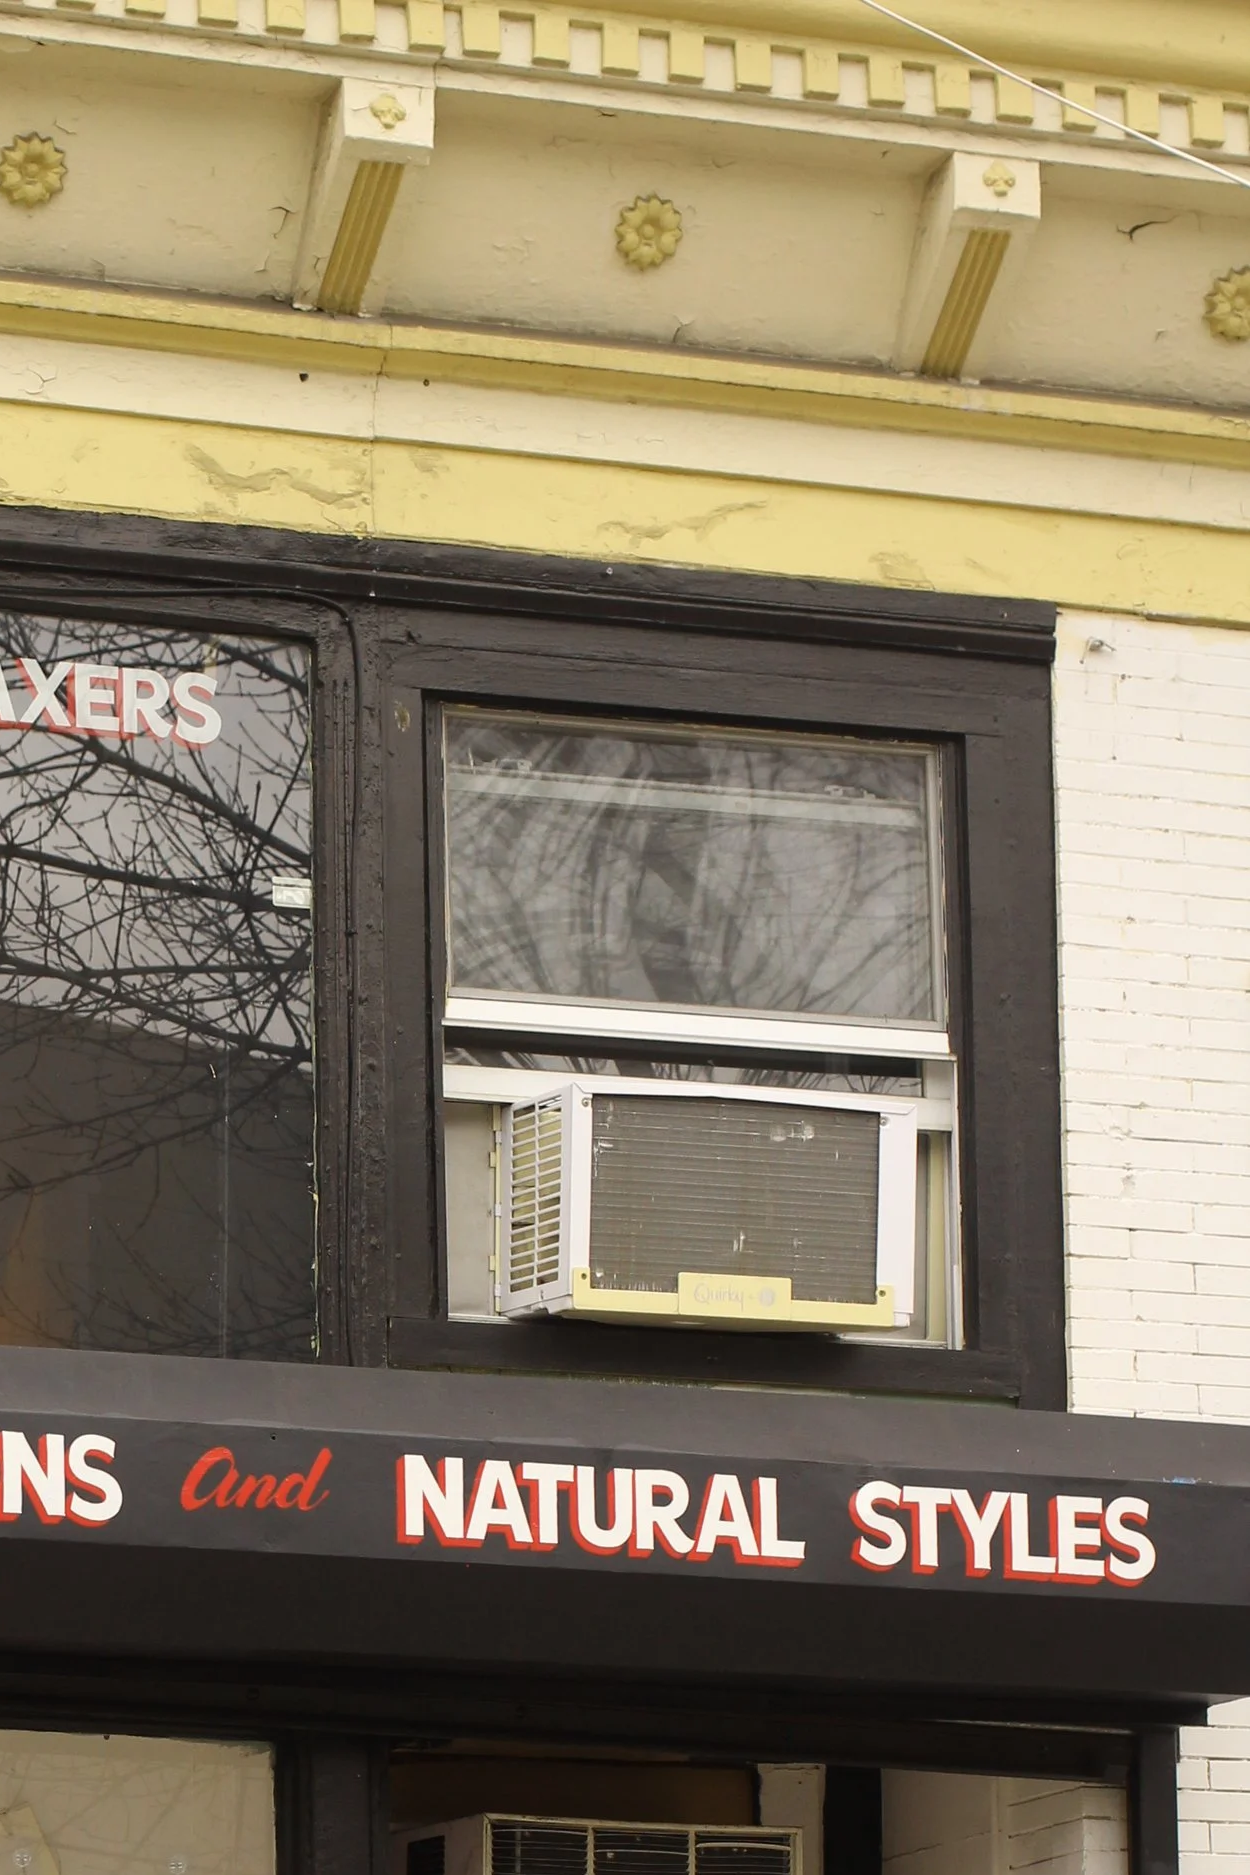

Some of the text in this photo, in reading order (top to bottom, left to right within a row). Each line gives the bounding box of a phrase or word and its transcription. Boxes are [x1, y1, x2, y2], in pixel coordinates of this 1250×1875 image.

[179, 1446, 333, 1512] And
[396, 1454, 807, 1567] NATURAL
[849, 1480, 1157, 1586] STYLES
